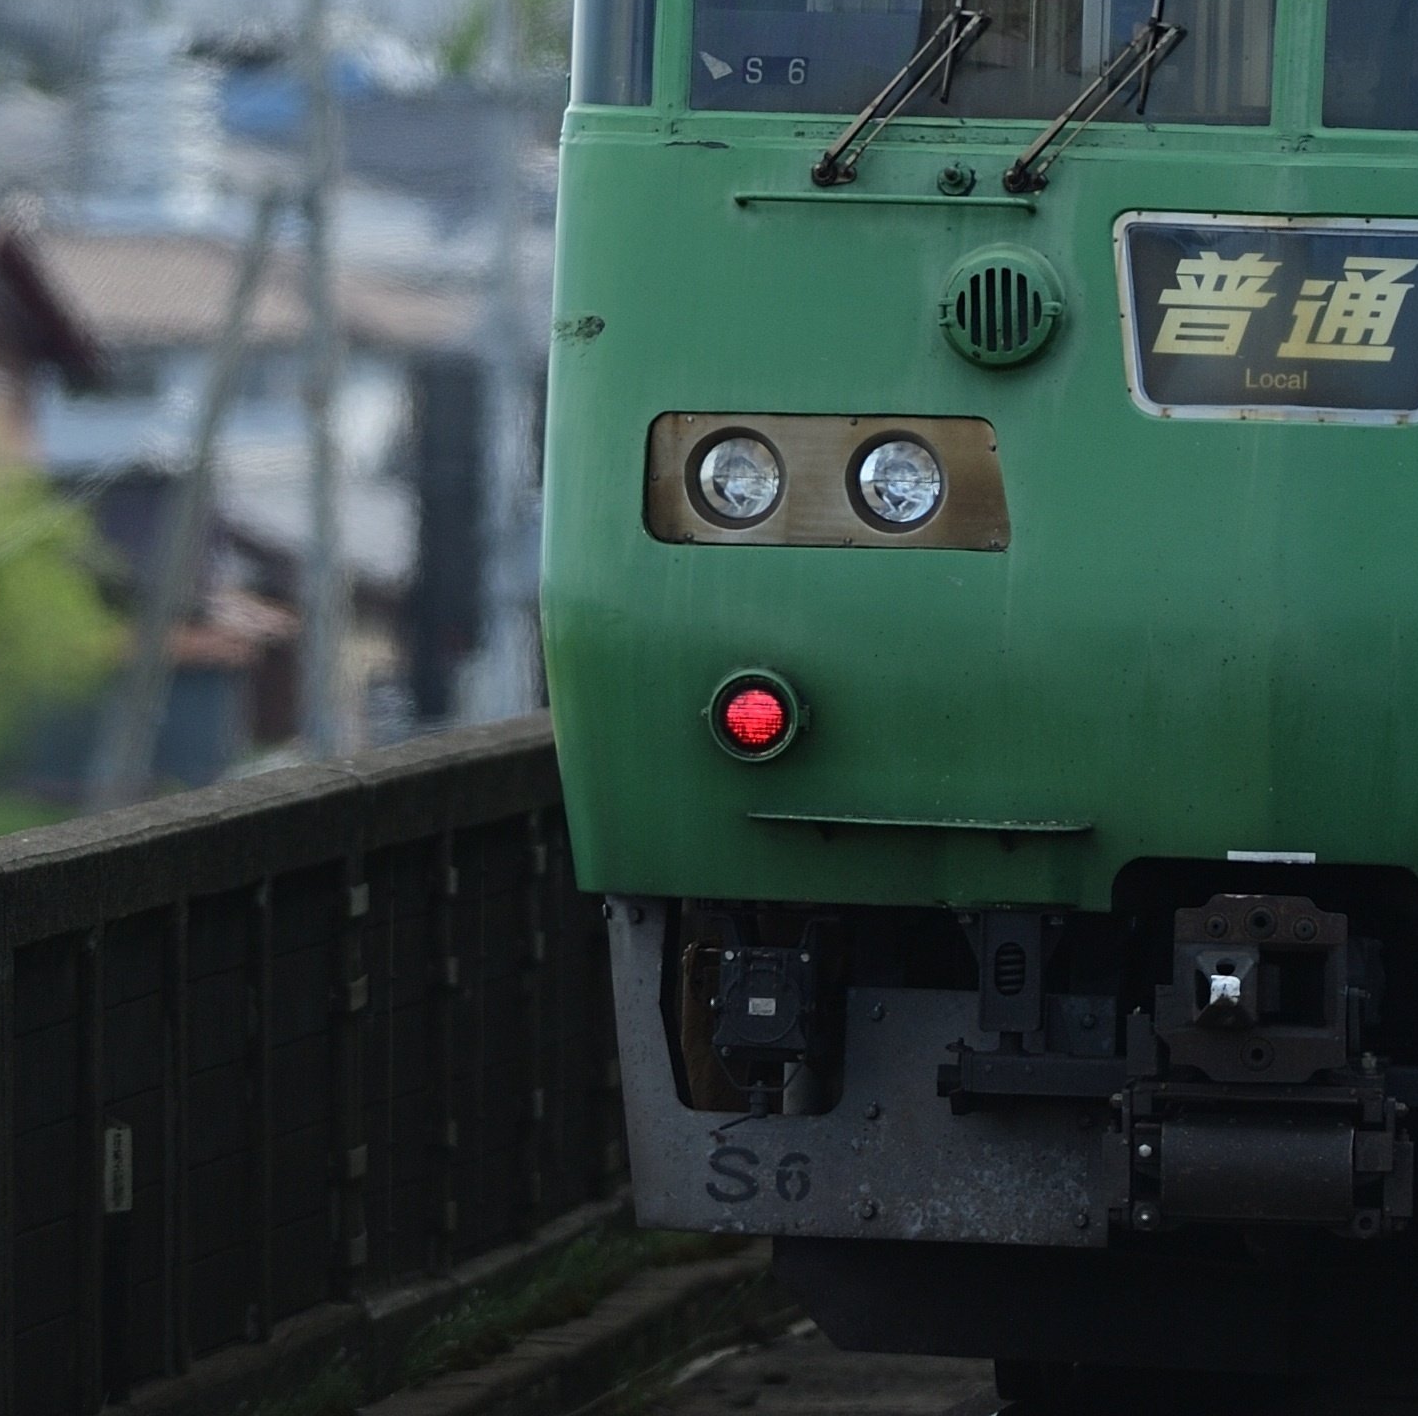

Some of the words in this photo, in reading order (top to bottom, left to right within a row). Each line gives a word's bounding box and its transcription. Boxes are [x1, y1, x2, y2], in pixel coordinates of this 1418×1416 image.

[745, 57, 763, 84] S
[788, 58, 806, 85] 6
[1245, 368, 1308, 391] Local
